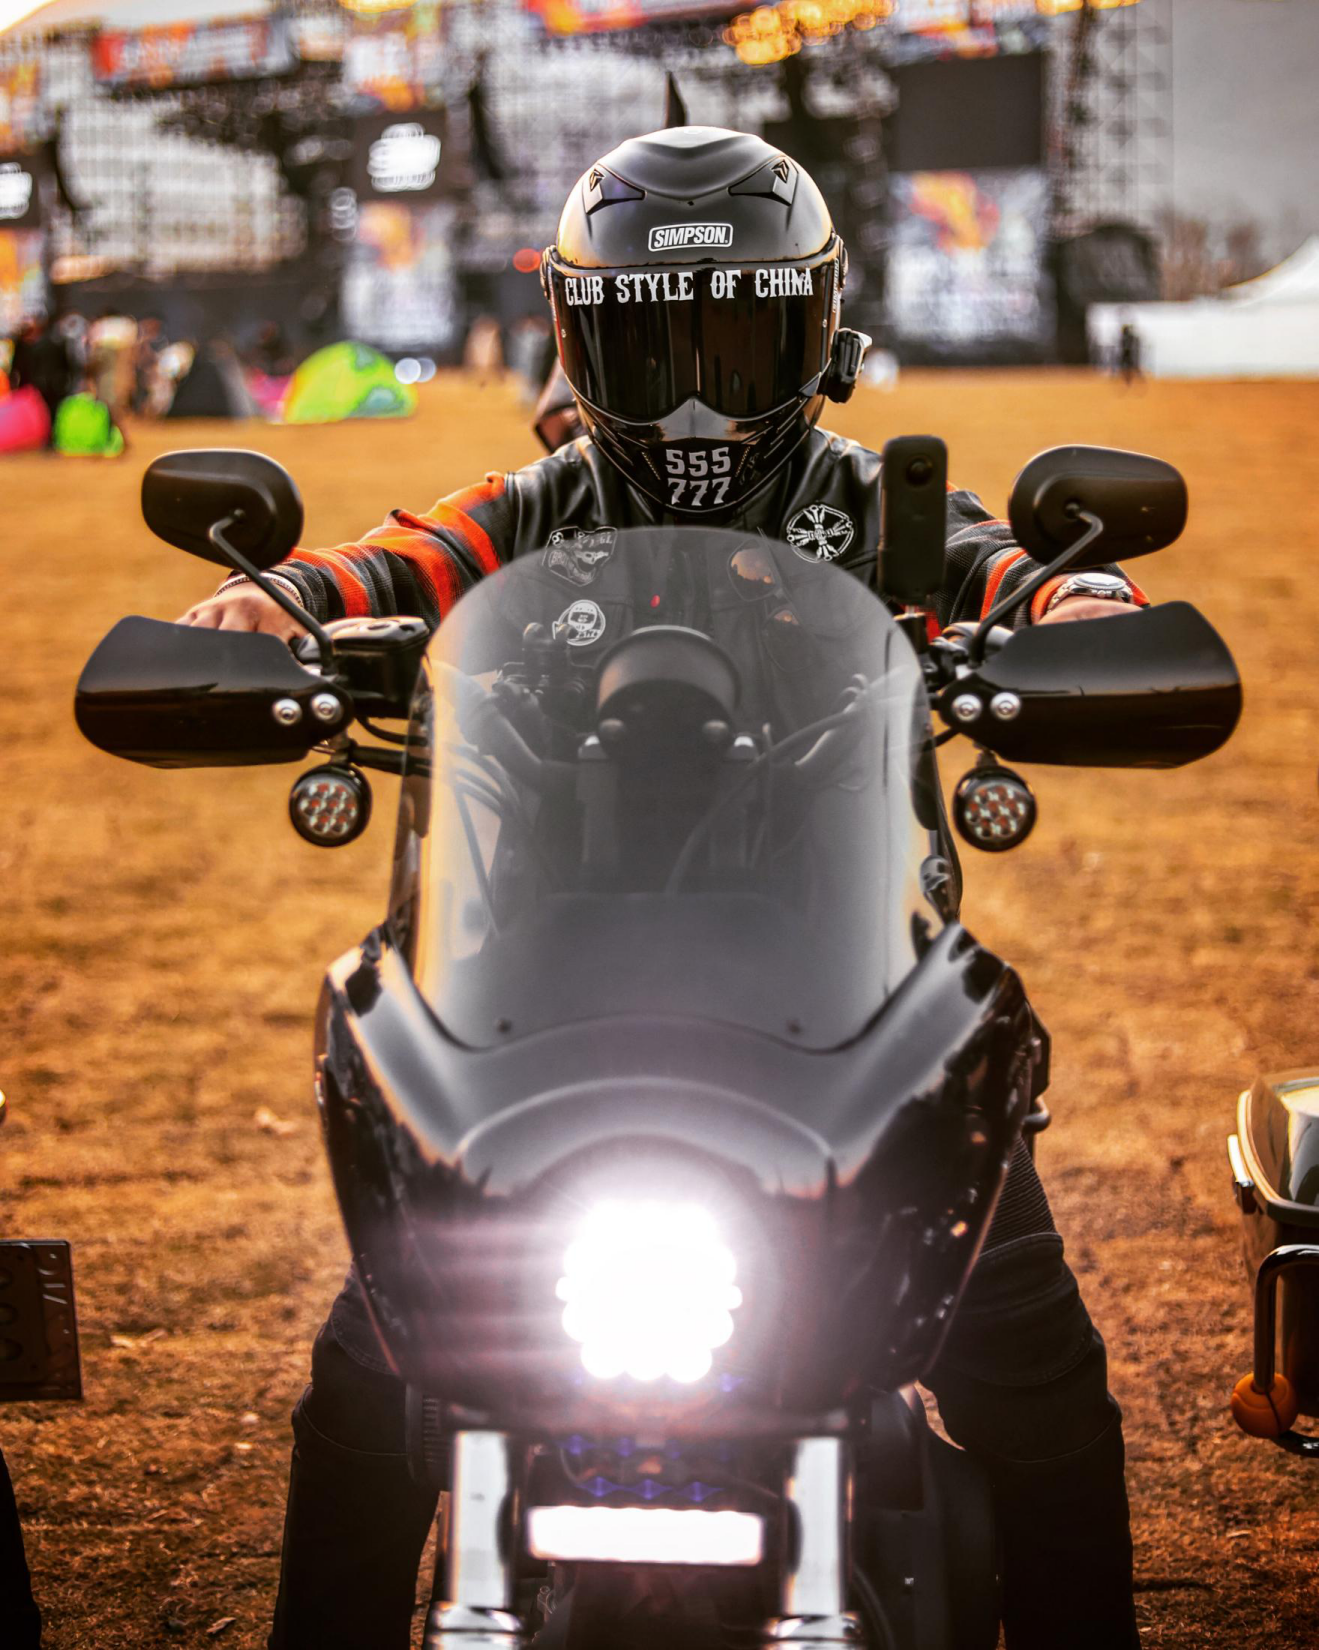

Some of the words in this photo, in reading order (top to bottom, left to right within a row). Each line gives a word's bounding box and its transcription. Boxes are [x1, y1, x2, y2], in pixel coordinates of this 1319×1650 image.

[564, 275, 605, 306] CLUB
[614, 272, 694, 304] STYLE
[710, 270, 742, 299] OF
[754, 267, 814, 298] CHINA
[665, 446, 731, 477] 555
[667, 476, 732, 507] 777
